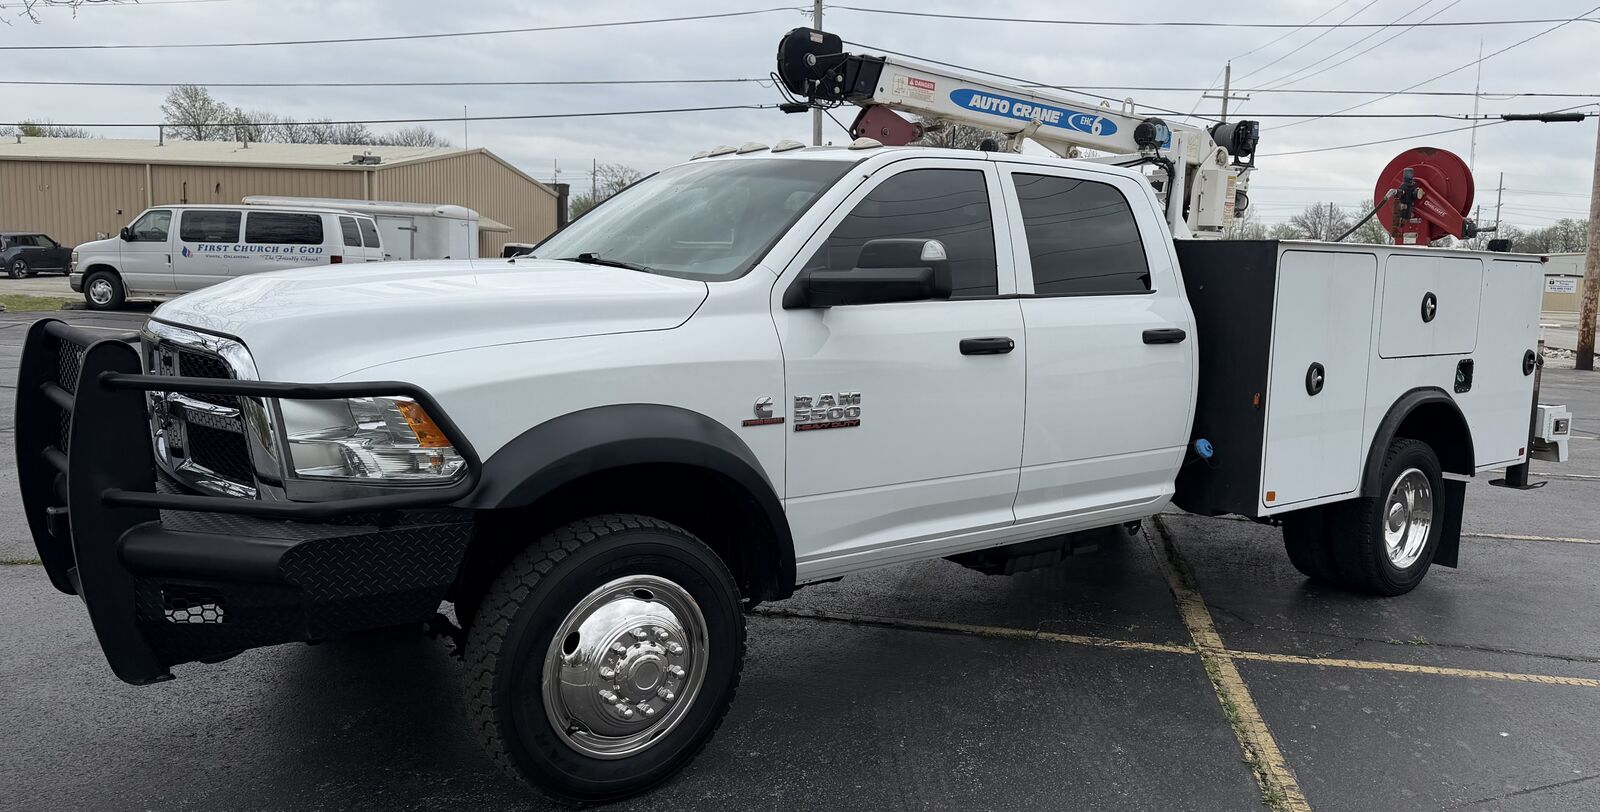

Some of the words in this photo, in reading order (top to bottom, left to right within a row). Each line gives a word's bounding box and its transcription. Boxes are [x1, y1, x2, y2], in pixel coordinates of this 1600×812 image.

[914, 80, 933, 89] DANGER
[968, 94, 1010, 113] AUTO
[1012, 102, 1061, 123] CRANE
[1080, 116, 1093, 127] EHC
[1091, 116, 1104, 136] 6
[197, 244, 229, 252] FIRST
[233, 245, 279, 253] CHURCH
[283, 245, 294, 253] of
[299, 246, 323, 254] GOD
[794, 392, 861, 408] RAM
[794, 406, 861, 422] 5500
[797, 422, 829, 431] HEAVY
[831, 420, 858, 429] DUTY
